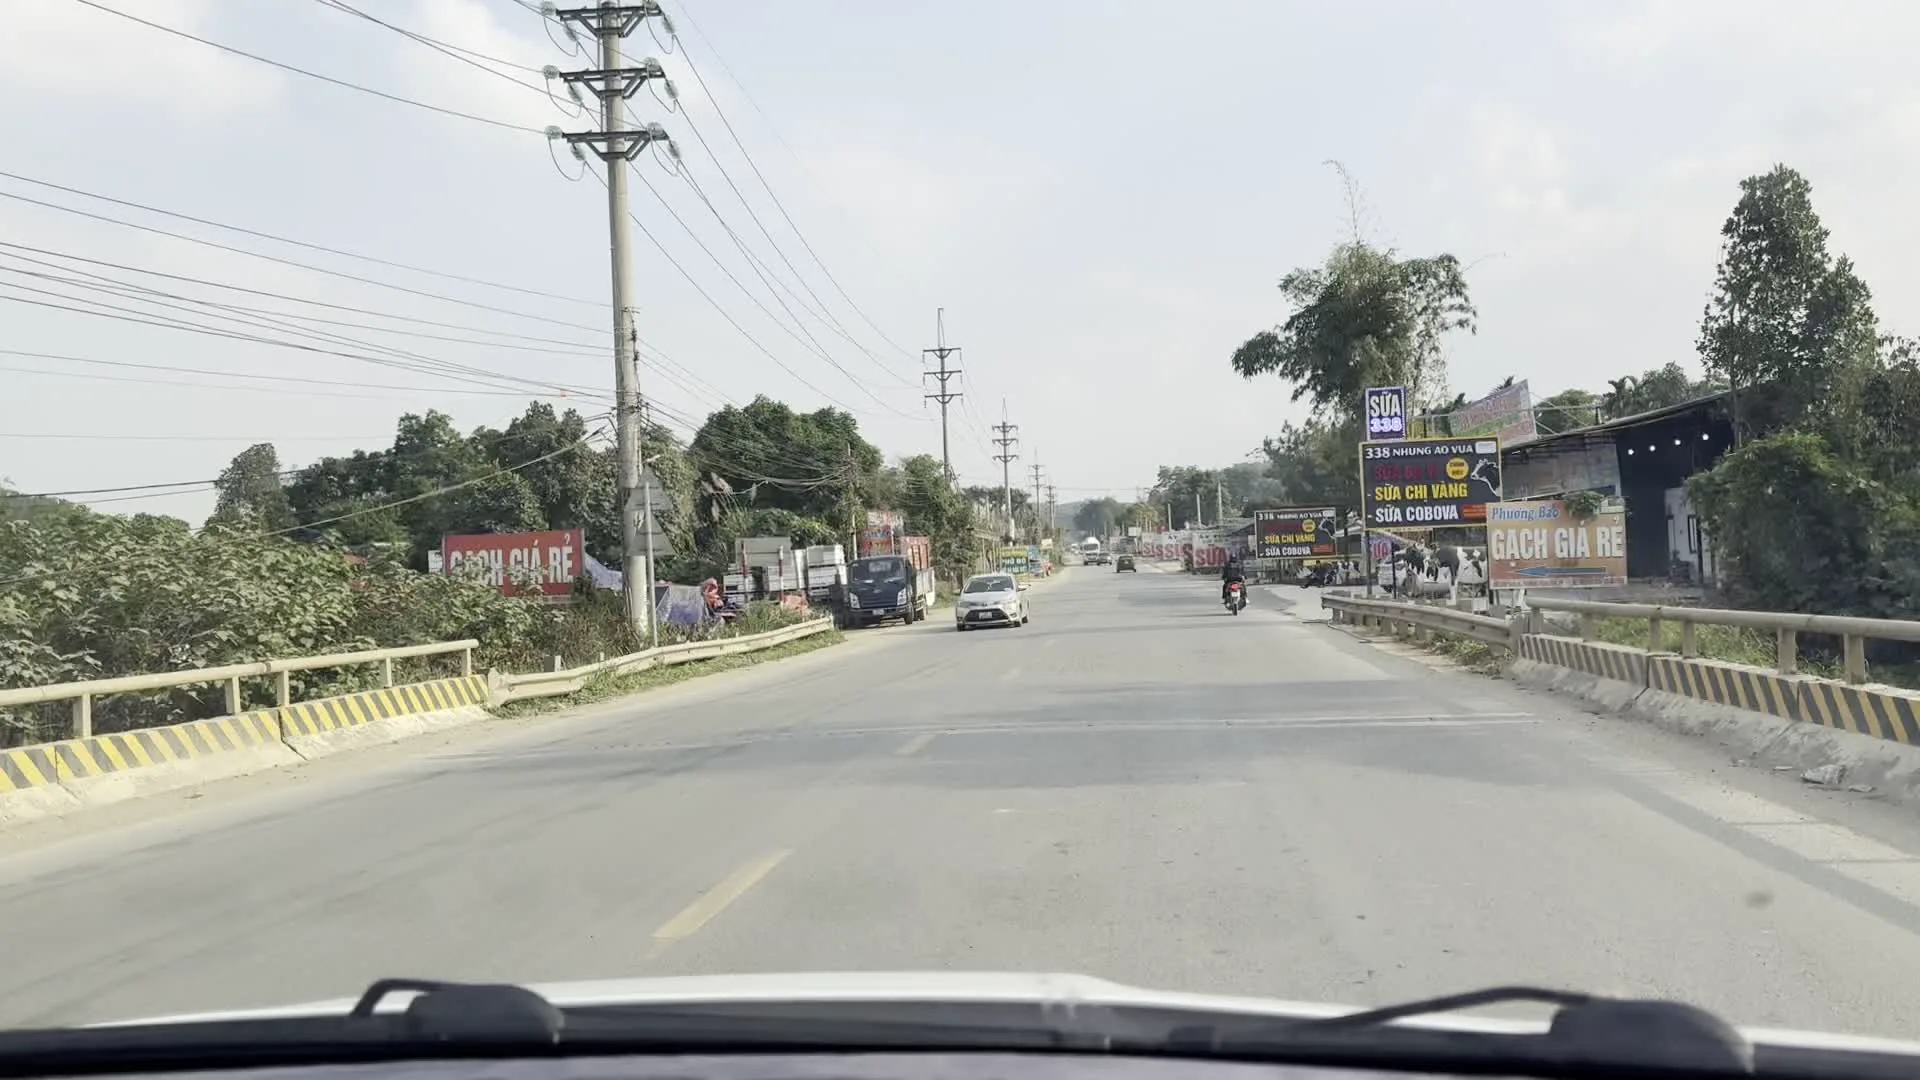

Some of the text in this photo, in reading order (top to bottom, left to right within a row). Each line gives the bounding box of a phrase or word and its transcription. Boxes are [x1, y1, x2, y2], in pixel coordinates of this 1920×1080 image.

[1369, 391, 1402, 417] SỮA
[1370, 416, 1402, 432] 338
[1365, 443, 1474, 459] 338 NHUNG AO VUA
[1375, 481, 1468, 503] SỮA CHỊ VÀNG
[1375, 504, 1402, 523] SỮA
[1406, 504, 1459, 522] COBOVA
[1491, 506, 1537, 521] Phương
[1491, 516, 1624, 567] GẠCH GIÁ RẺ
[548, 533, 574, 584] RẺ
